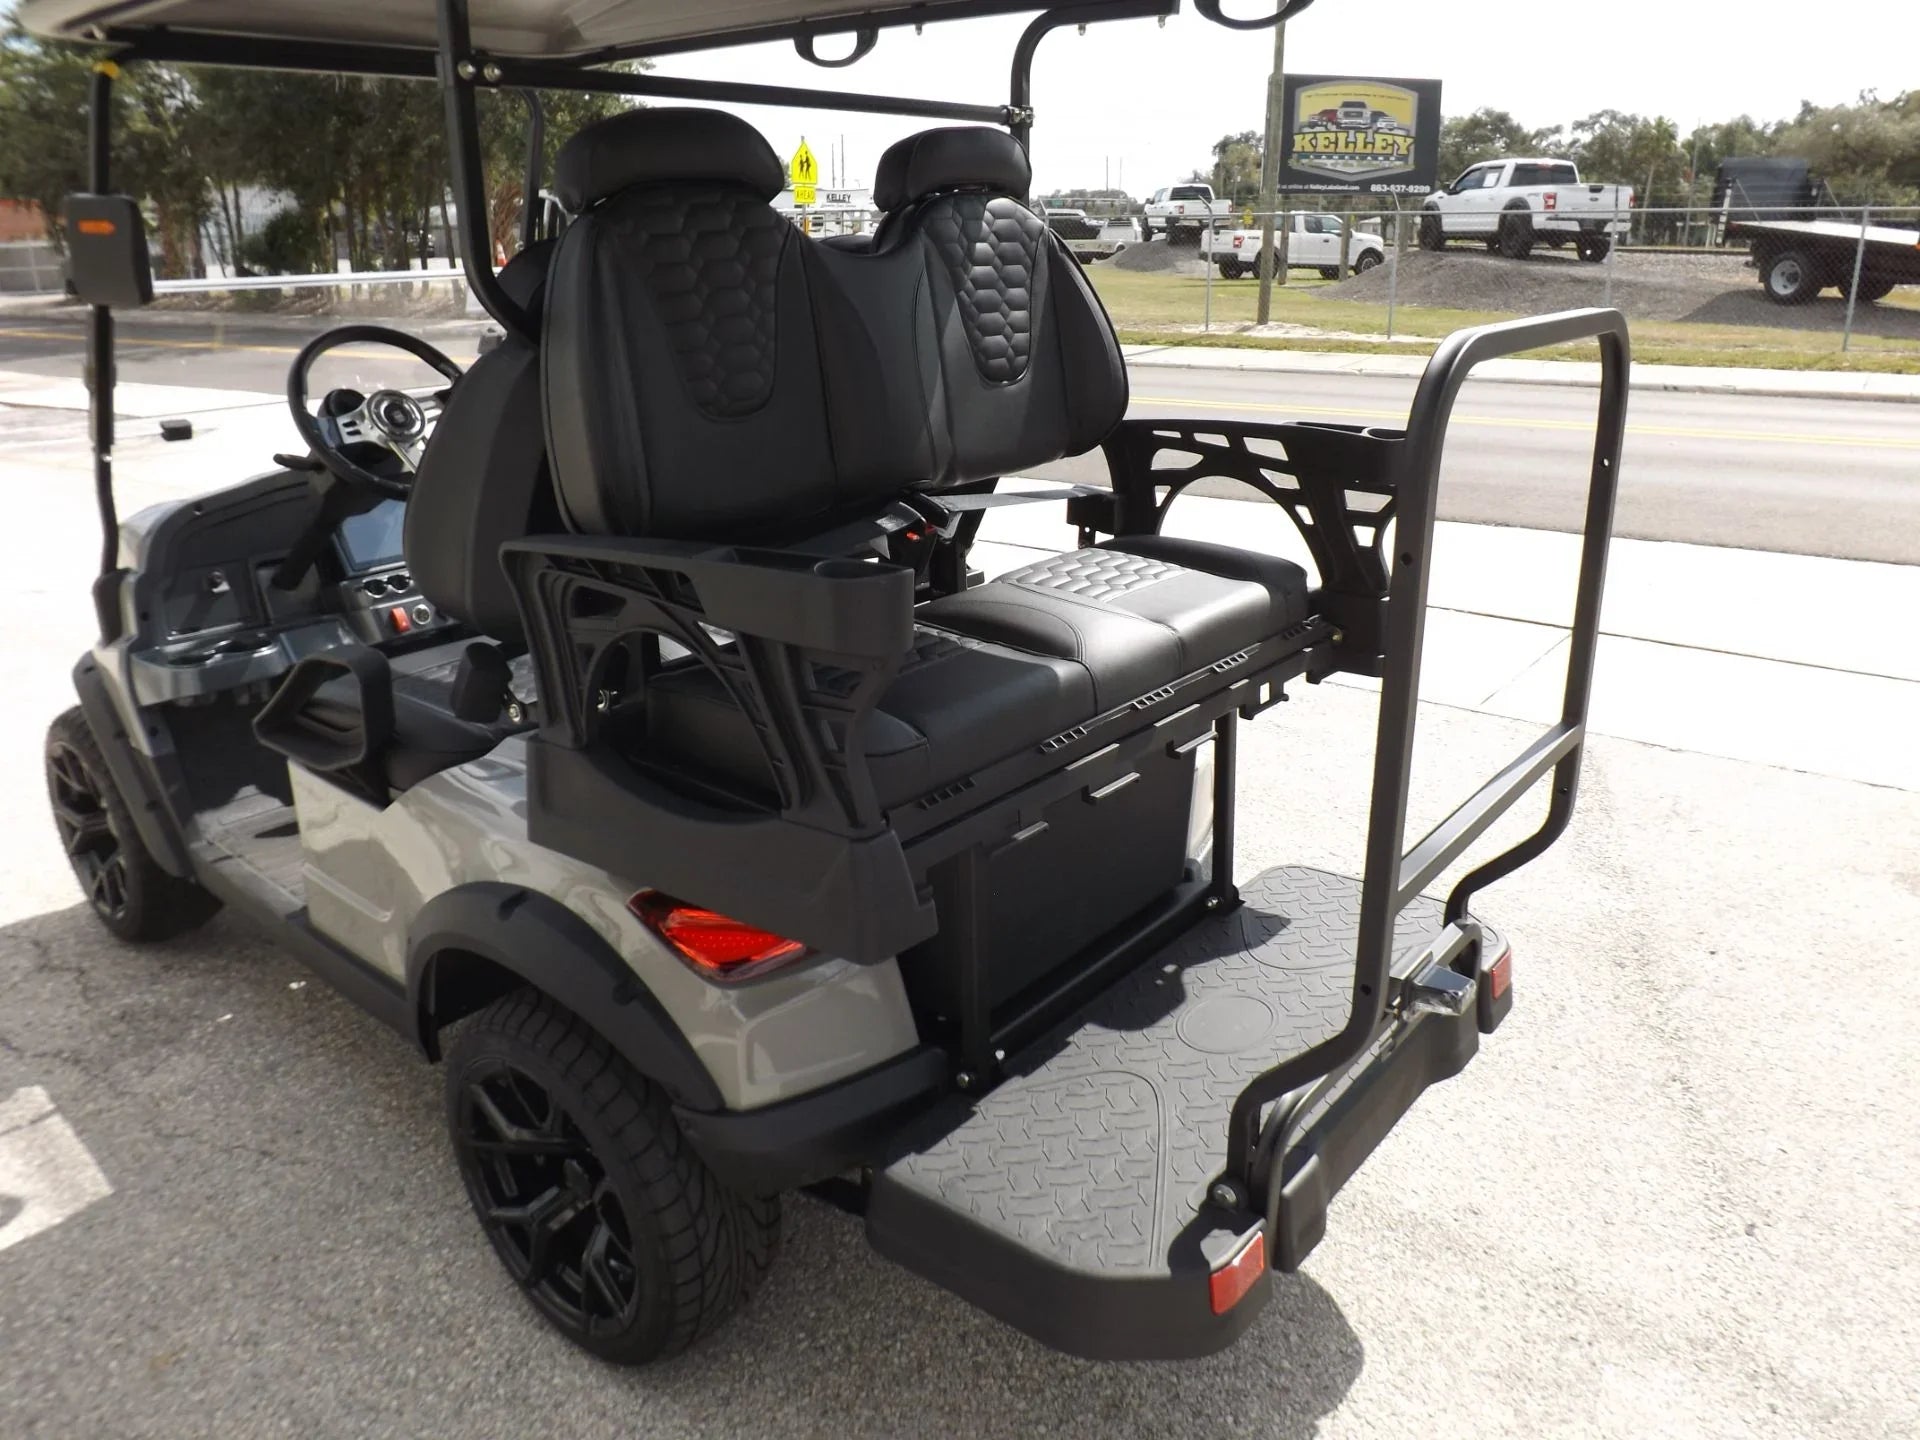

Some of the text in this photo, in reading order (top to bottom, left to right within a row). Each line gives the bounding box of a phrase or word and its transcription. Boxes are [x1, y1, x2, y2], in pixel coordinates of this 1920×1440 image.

[1293, 131, 1416, 156] KELLEY
[796, 190, 814, 200] AHEAD
[826, 193, 851, 202] KELLEY
